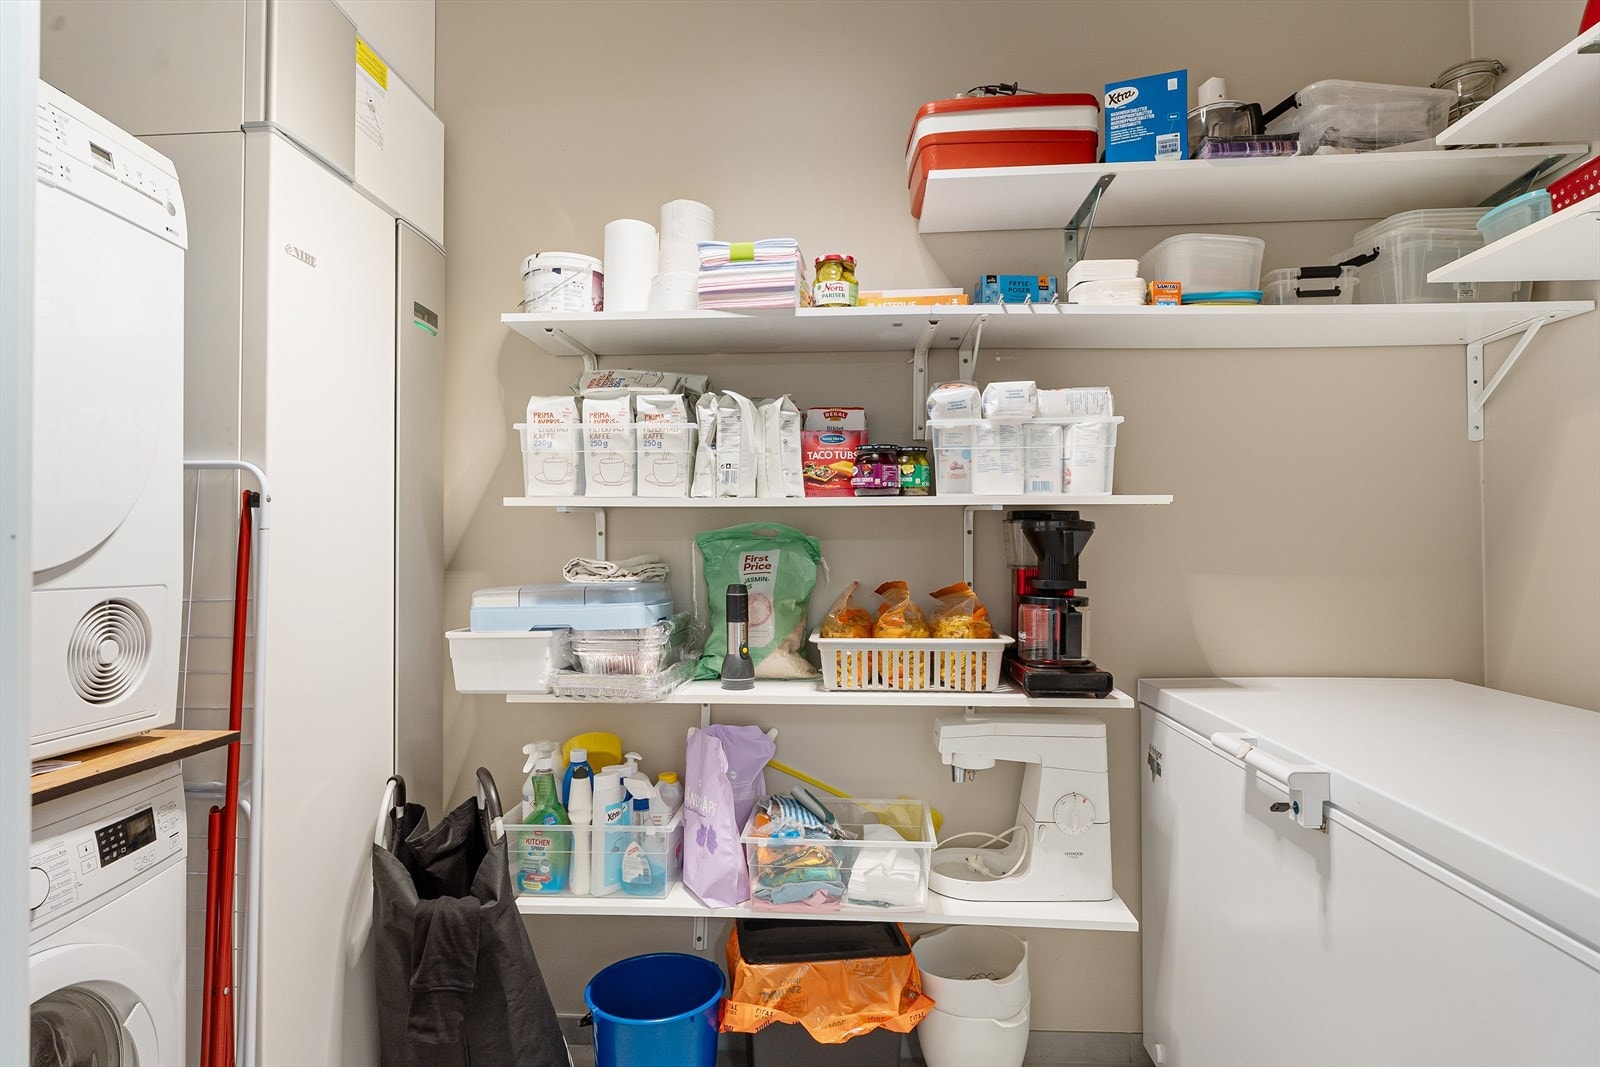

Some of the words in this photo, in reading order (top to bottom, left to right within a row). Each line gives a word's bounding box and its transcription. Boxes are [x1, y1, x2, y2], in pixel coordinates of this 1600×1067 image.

[1108, 90, 1136, 106] Xtra
[292, 246, 317, 269] NIBE
[821, 282, 846, 293] Nora
[533, 432, 556, 440] KAFFE
[589, 432, 611, 440] KAFFE
[643, 432, 665, 440] KAFFE
[806, 450, 833, 460] TACO
[744, 563, 772, 571] Price
[525, 838, 551, 846] KITCHEN
